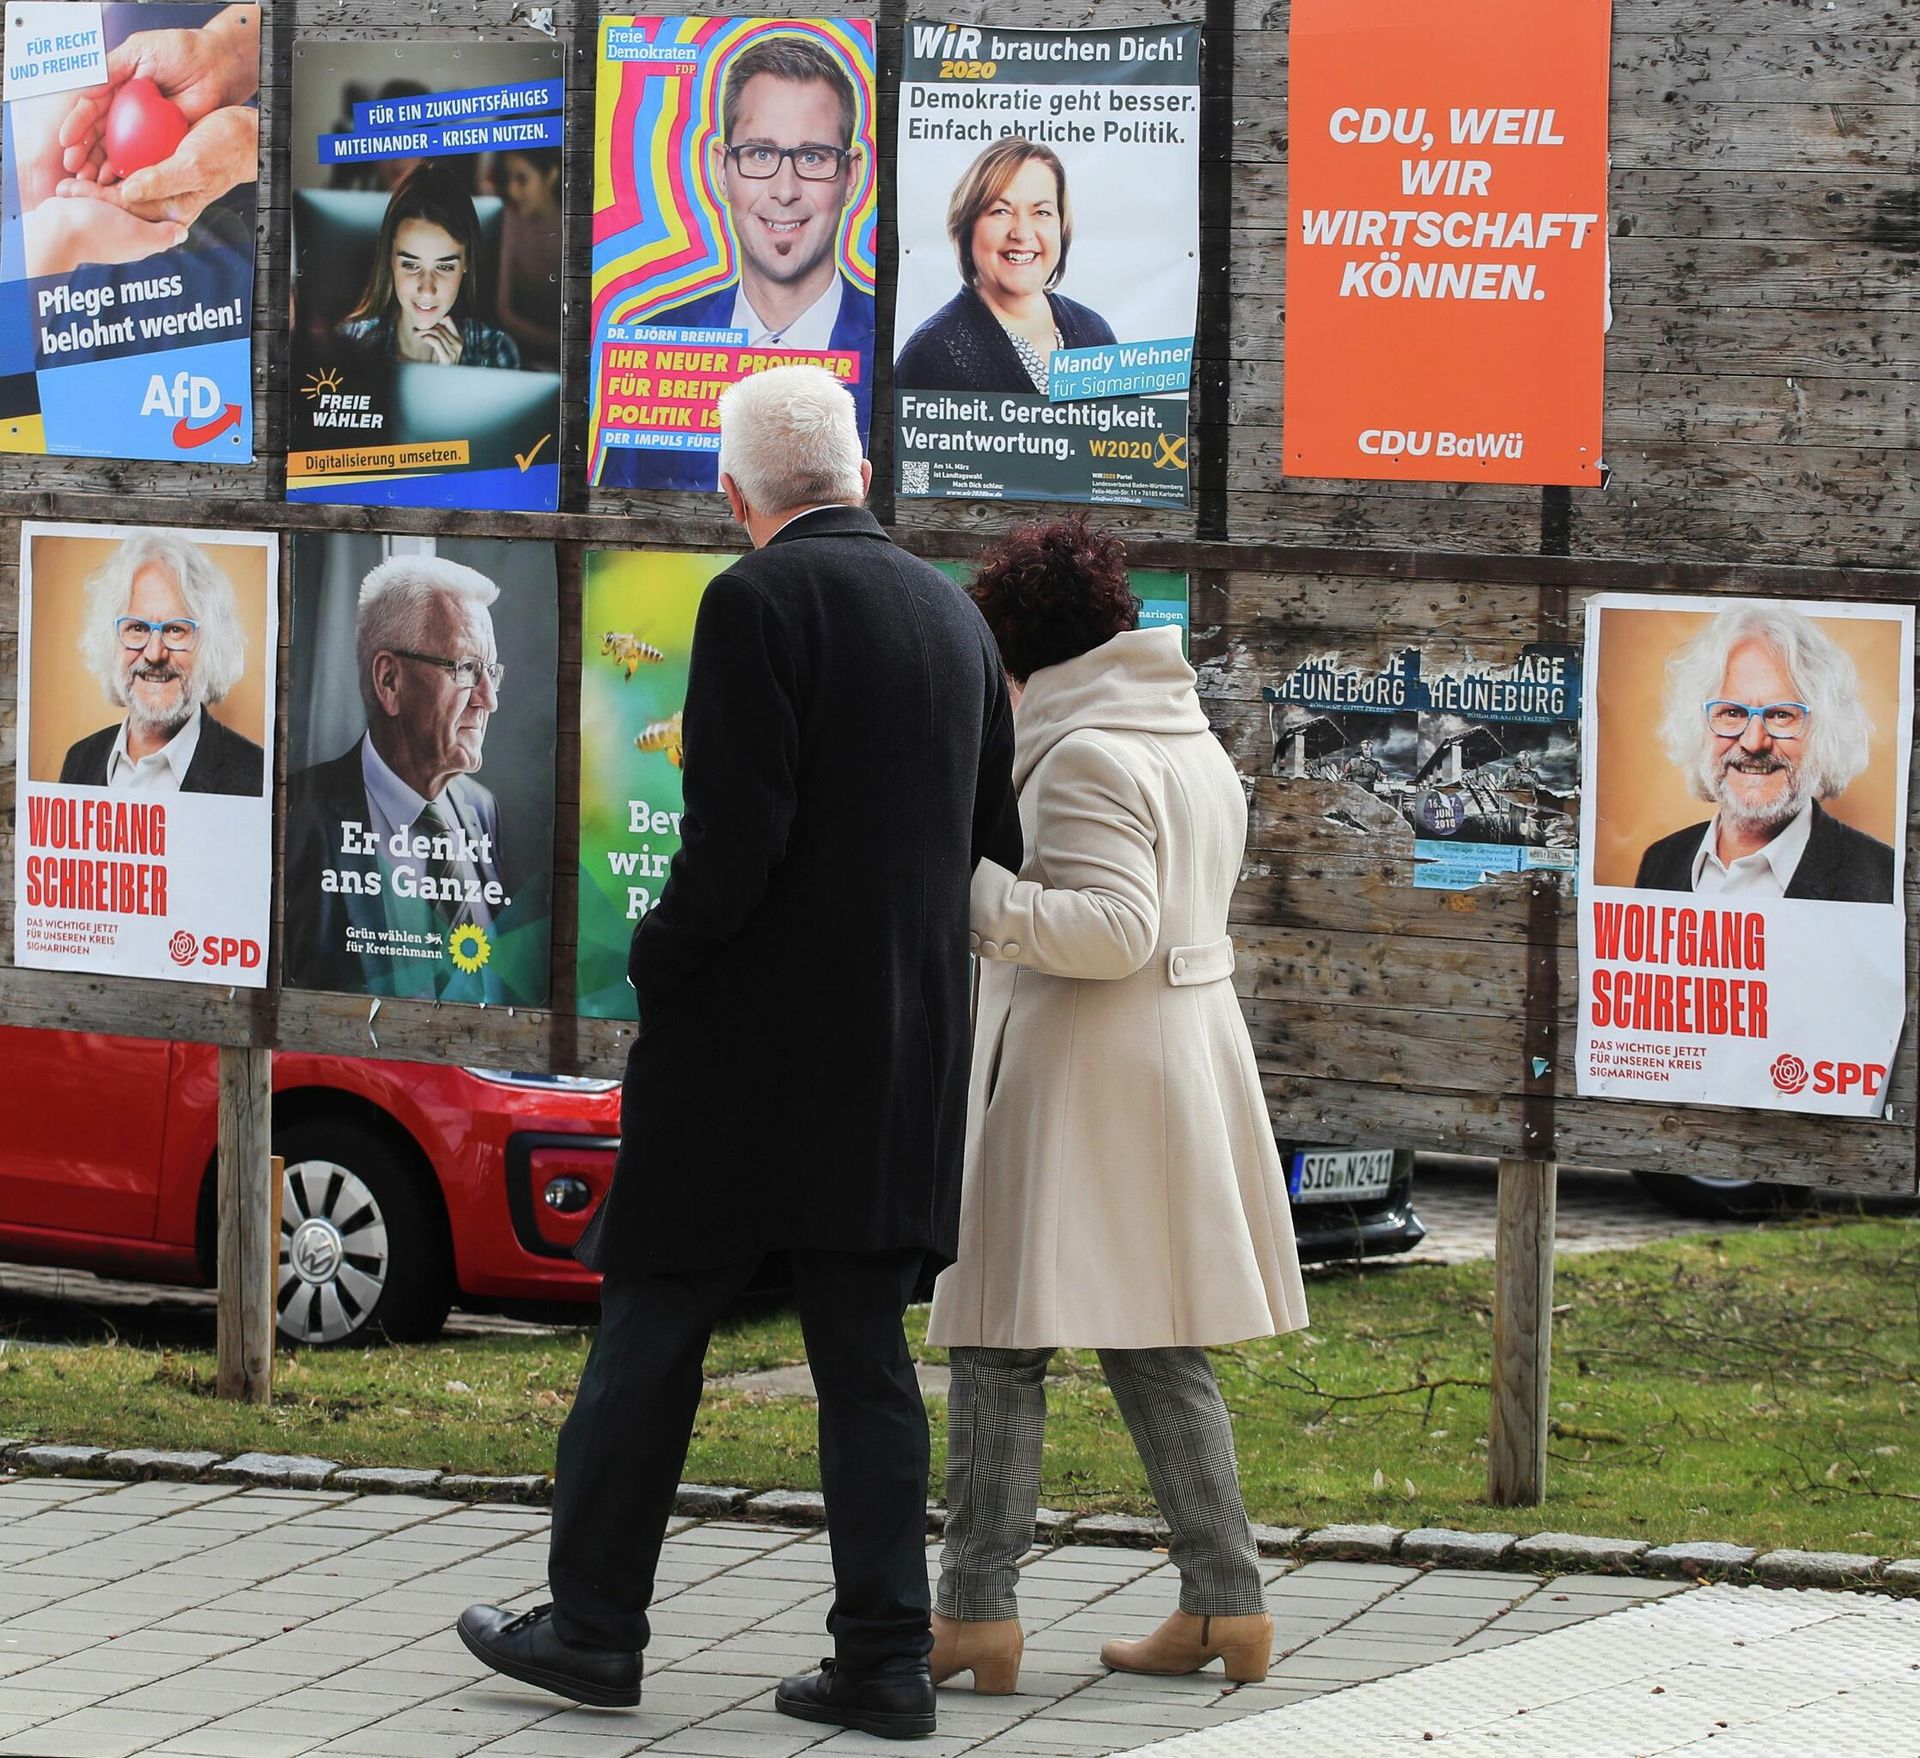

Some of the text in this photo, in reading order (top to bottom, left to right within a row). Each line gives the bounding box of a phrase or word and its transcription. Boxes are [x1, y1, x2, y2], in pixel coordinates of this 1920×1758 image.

[27, 30, 97, 57] FÜR RECHT
[608, 28, 643, 44] Freie
[990, 36, 1111, 61] brauchen
[1118, 36, 1184, 61] Dich!
[607, 44, 697, 60] Demokraten
[10, 51, 100, 81] UND FREIHEIT
[675, 64, 696, 74] FDP
[939, 61, 997, 80] 2020
[368, 88, 549, 125] FÜR EIN ZUKUNFTSFÄHIGES
[910, 86, 1196, 116] Demokratie geht besser.
[334, 133, 429, 157] MITEINANDER
[442, 128, 489, 148] KRISEN
[492, 123, 549, 143] NUTZEN.
[908, 118, 1185, 144] Einfach ehrliche Politik.
[1328, 107, 1565, 152] CDU, WEIL
[1401, 159, 1493, 196] WIR
[1302, 209, 1599, 250] WIRTSCHAFT
[1339, 251, 1546, 301] KÖNNEN.
[38, 275, 183, 317] Pflege muss
[41, 298, 243, 355] belohnt werden!
[607, 327, 744, 344] DR. BJÖRN BRENNER
[608, 349, 649, 370] IHR
[655, 351, 729, 373] NEUER
[1053, 346, 1192, 375] Mandy Wehner
[140, 372, 221, 419] AfD
[607, 373, 650, 398] FÜR
[1054, 371, 1186, 398] für Sigmaringen
[320, 394, 371, 411] FREIE
[902, 396, 1163, 432] Freiheit. Gerechtigkeit.
[312, 410, 384, 429] WÄHLER
[606, 405, 693, 428] POLITIK
[605, 432, 630, 445] DER
[634, 433, 683, 447] IMPULS
[901, 427, 1152, 460] Verantwortung. W2020
[1358, 429, 1524, 459] CDU BaWü
[305, 447, 462, 472] Digitalisierung umsetzen.
[942, 472, 983, 480] Landtagswahl
[969, 481, 982, 489] Dich
[1092, 480, 1132, 488] Landesverband
[1430, 681, 1564, 715] HEUNEBURG
[27, 796, 167, 856] WOLFGANG
[1434, 808, 1455, 819] JUNI
[340, 821, 492, 864] Er denkt
[607, 844, 669, 878] wir
[26, 855, 168, 917] SCHREIBER
[321, 865, 512, 906] ans Ganze.
[27, 917, 119, 934] DAS WICHTIGE JETZT
[27, 929, 116, 945] FÜR UNSEREN KREIS
[345, 926, 422, 944] Grün wählen
[1593, 902, 1765, 971] WOLFGANG
[26, 941, 90, 955] SIGMARINGEN
[202, 935, 261, 969] SPD
[345, 940, 443, 960] für Kretschmann
[1592, 968, 1768, 1039] SCHREIBER
[1590, 1039, 1707, 1058] DAS WICHTIGE JETZT
[1590, 1051, 1702, 1070] FÜR UNSEREN KREIS
[1590, 1067, 1669, 1082] SIGMARINGEN
[1812, 1061, 1887, 1096] SPD
[1303, 1157, 1337, 1189] SIG
